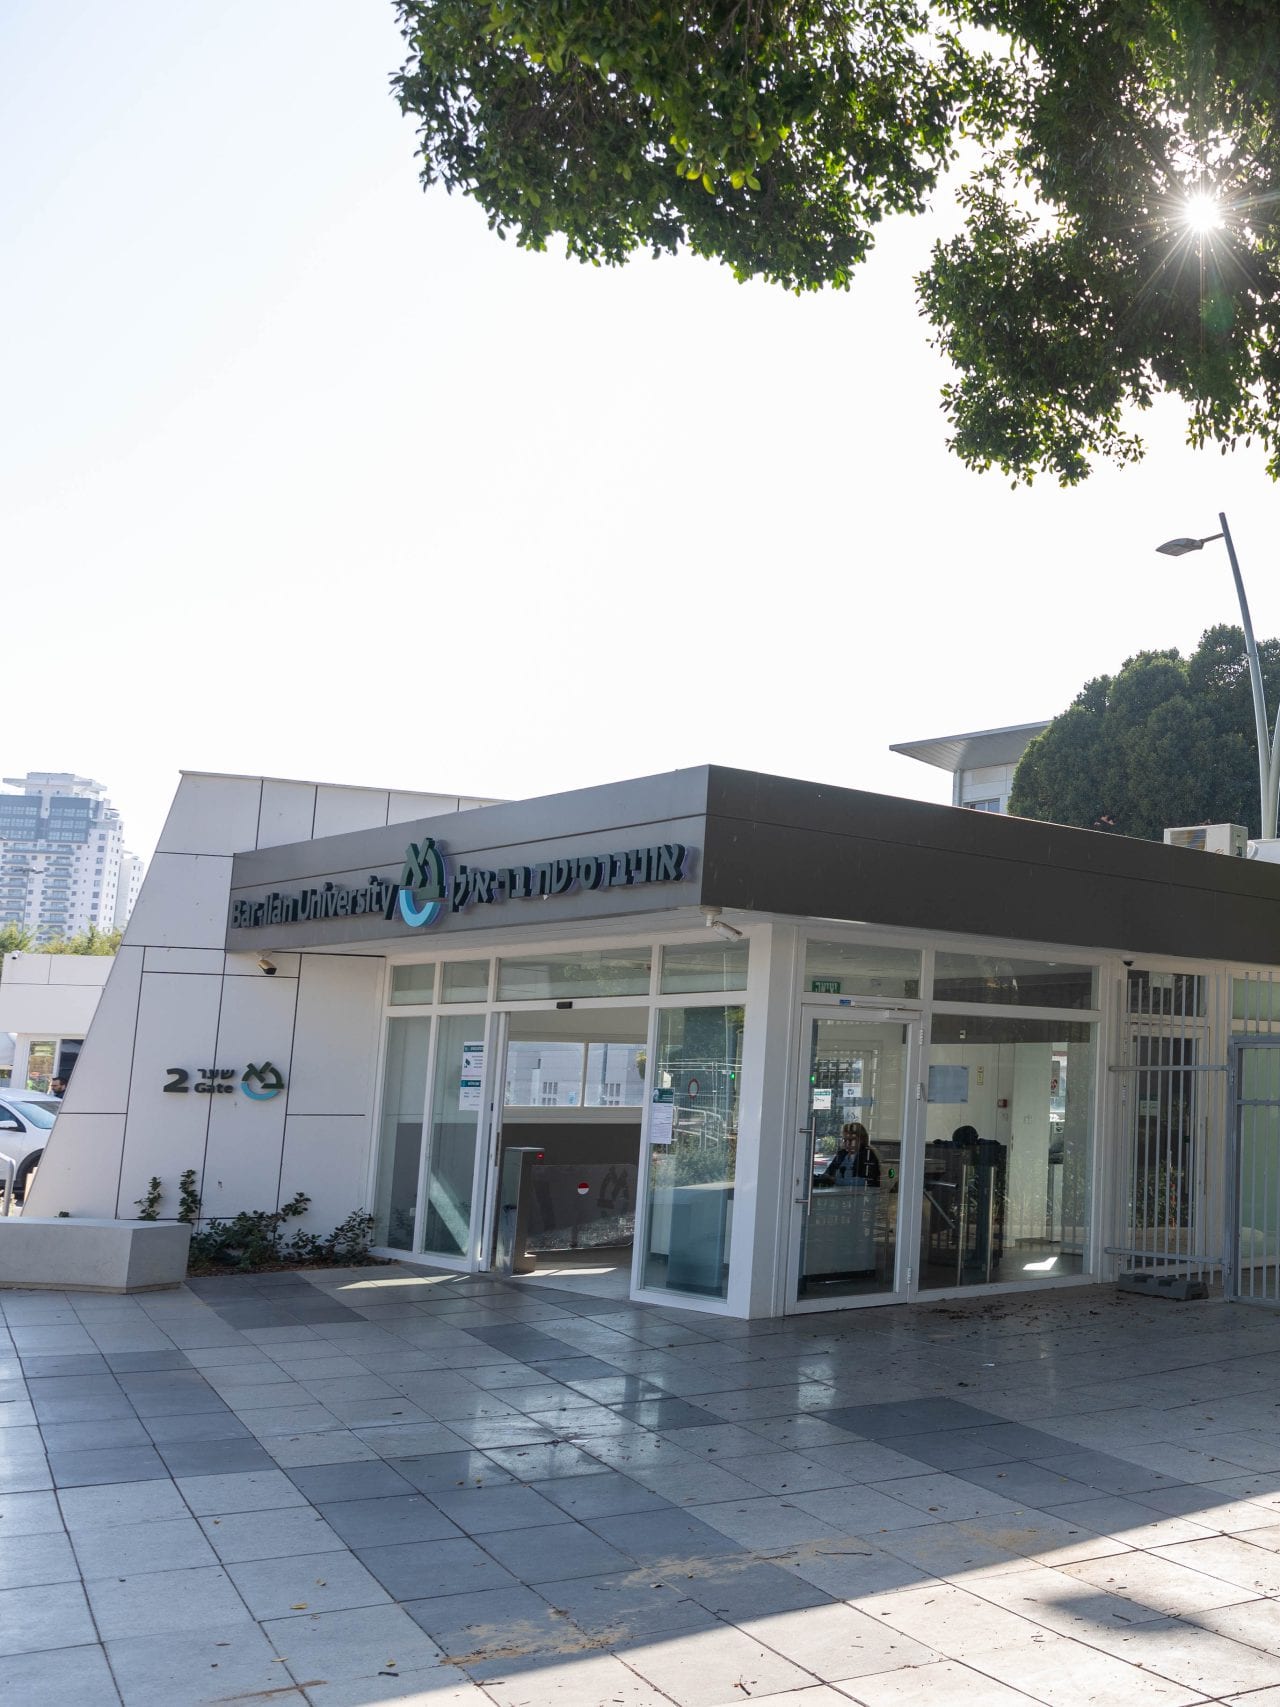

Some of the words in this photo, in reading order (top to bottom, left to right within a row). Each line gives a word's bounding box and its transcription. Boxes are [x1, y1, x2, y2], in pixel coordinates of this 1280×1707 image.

[531, 844, 686, 896] אוניברסיטת
[299, 875, 400, 920] University
[450, 865, 528, 913] בר-אילן
[163, 1067, 189, 1093] 2
[194, 1082, 234, 1094] Gate
[197, 1068, 235, 1080] שער
